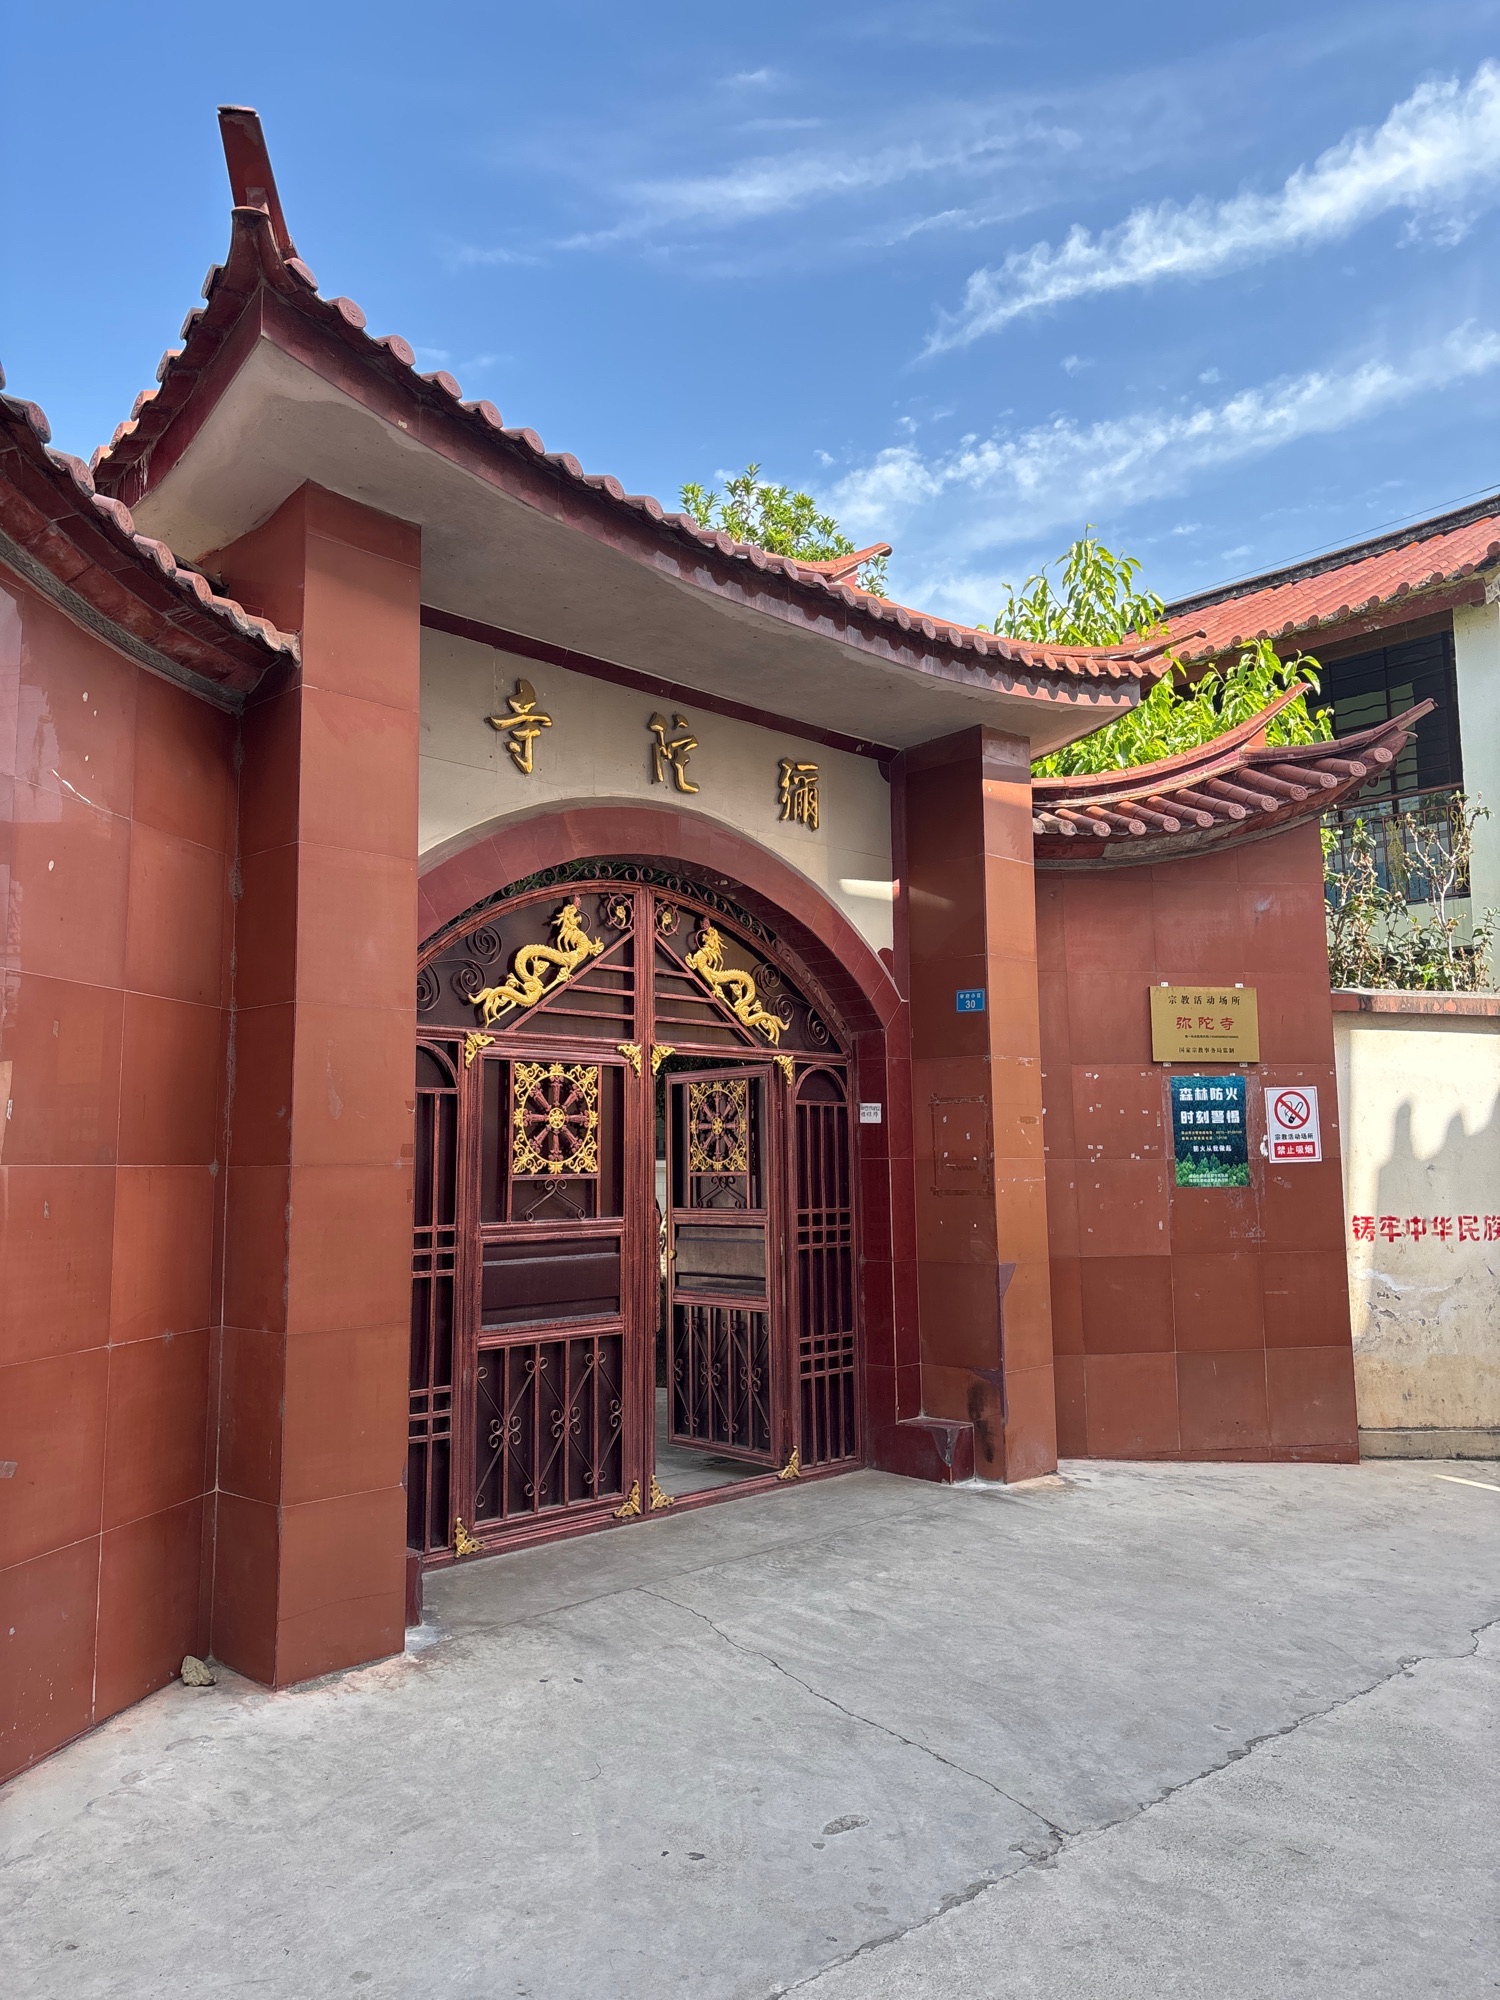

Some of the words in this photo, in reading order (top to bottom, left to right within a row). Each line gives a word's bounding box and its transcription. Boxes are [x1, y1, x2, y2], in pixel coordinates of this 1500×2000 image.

[965, 1000, 976, 1008] 30
[1168, 995, 1241, 1006] 宗教活动场所
[1176, 1016, 1235, 1031] 弥陀寺
[1179, 1087, 1239, 1101] 森林防火
[1180, 1110, 1240, 1124] 时刻警惕
[1275, 1133, 1314, 1141] 宗教活动场所
[1277, 1145, 1314, 1155] 禁止吸烟
